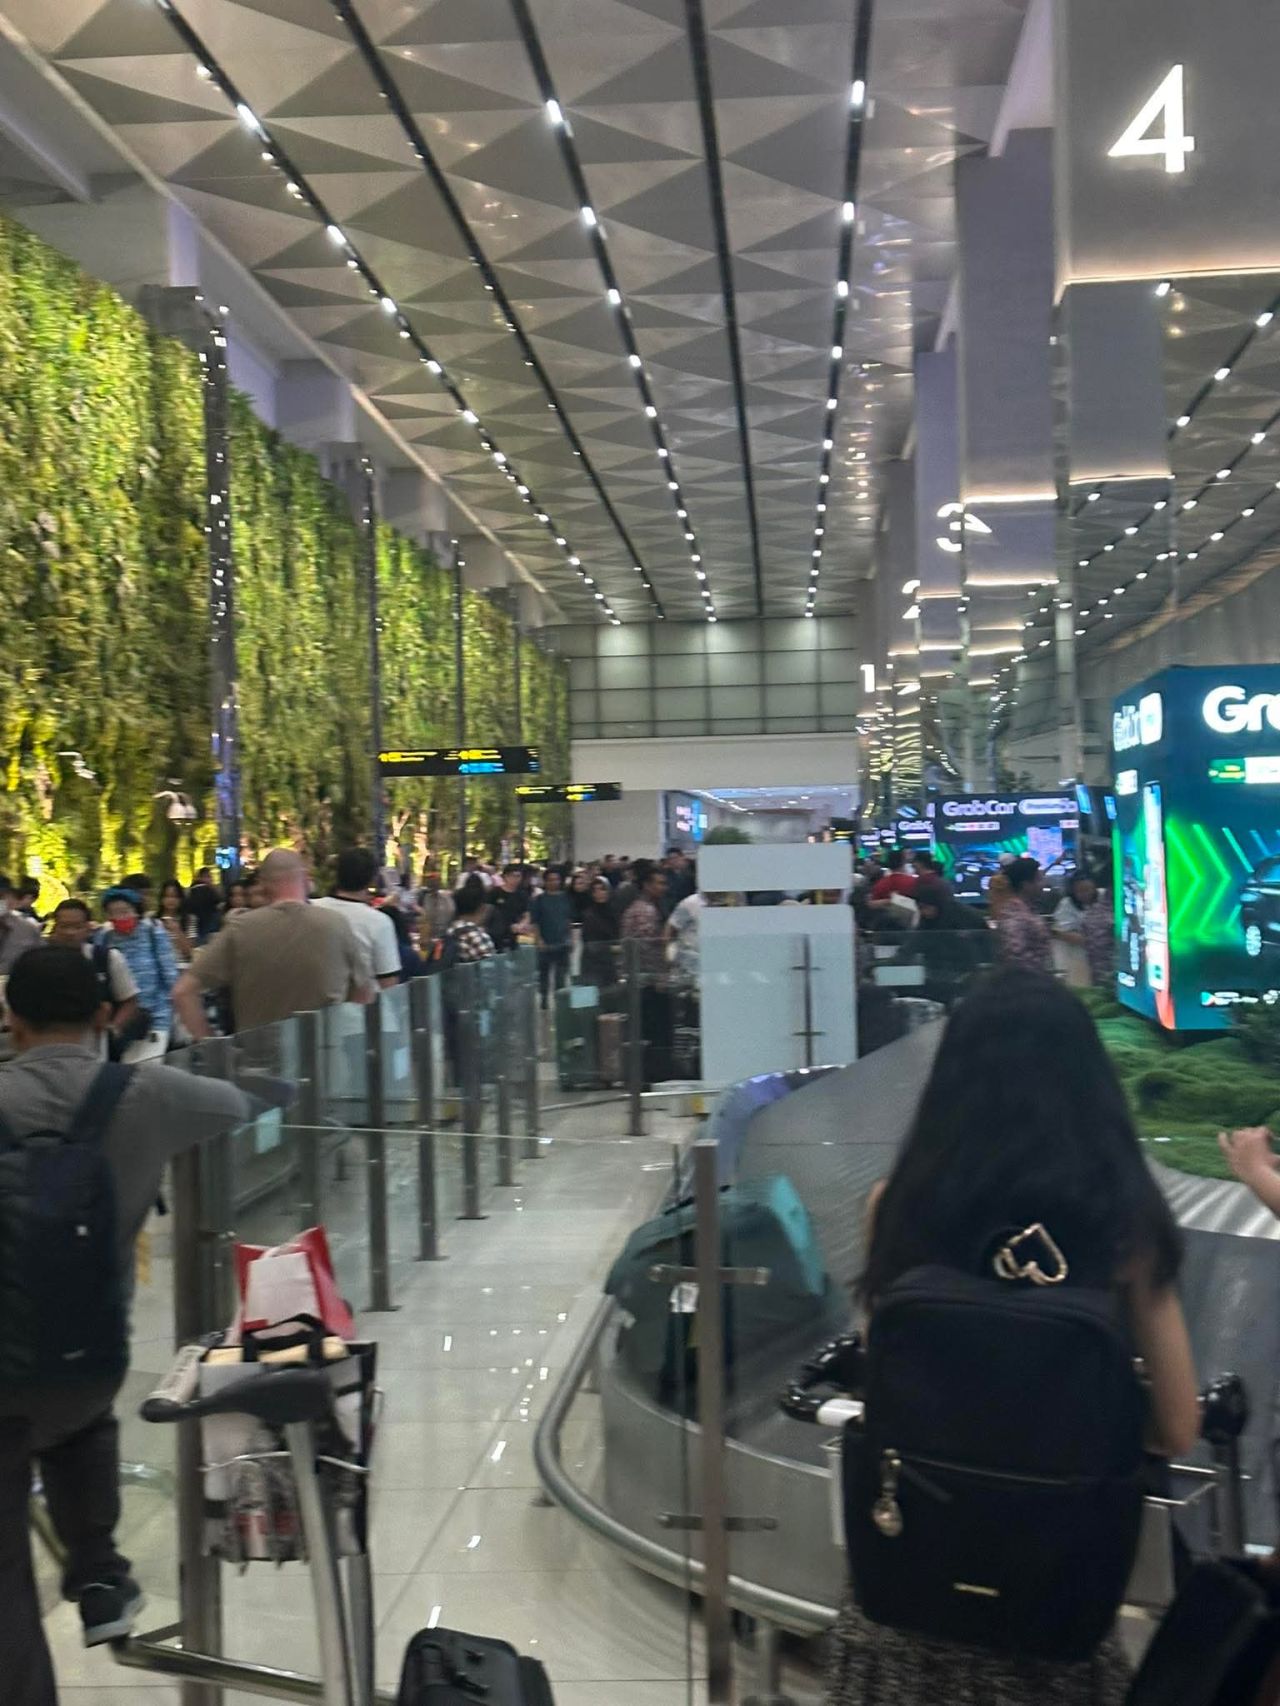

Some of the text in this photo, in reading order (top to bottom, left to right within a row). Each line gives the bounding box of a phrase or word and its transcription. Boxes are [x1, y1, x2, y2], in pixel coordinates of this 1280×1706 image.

[1107, 64, 1195, 174] 4
[860, 663, 876, 693] 1
[942, 800, 1017, 816] GrabCar
